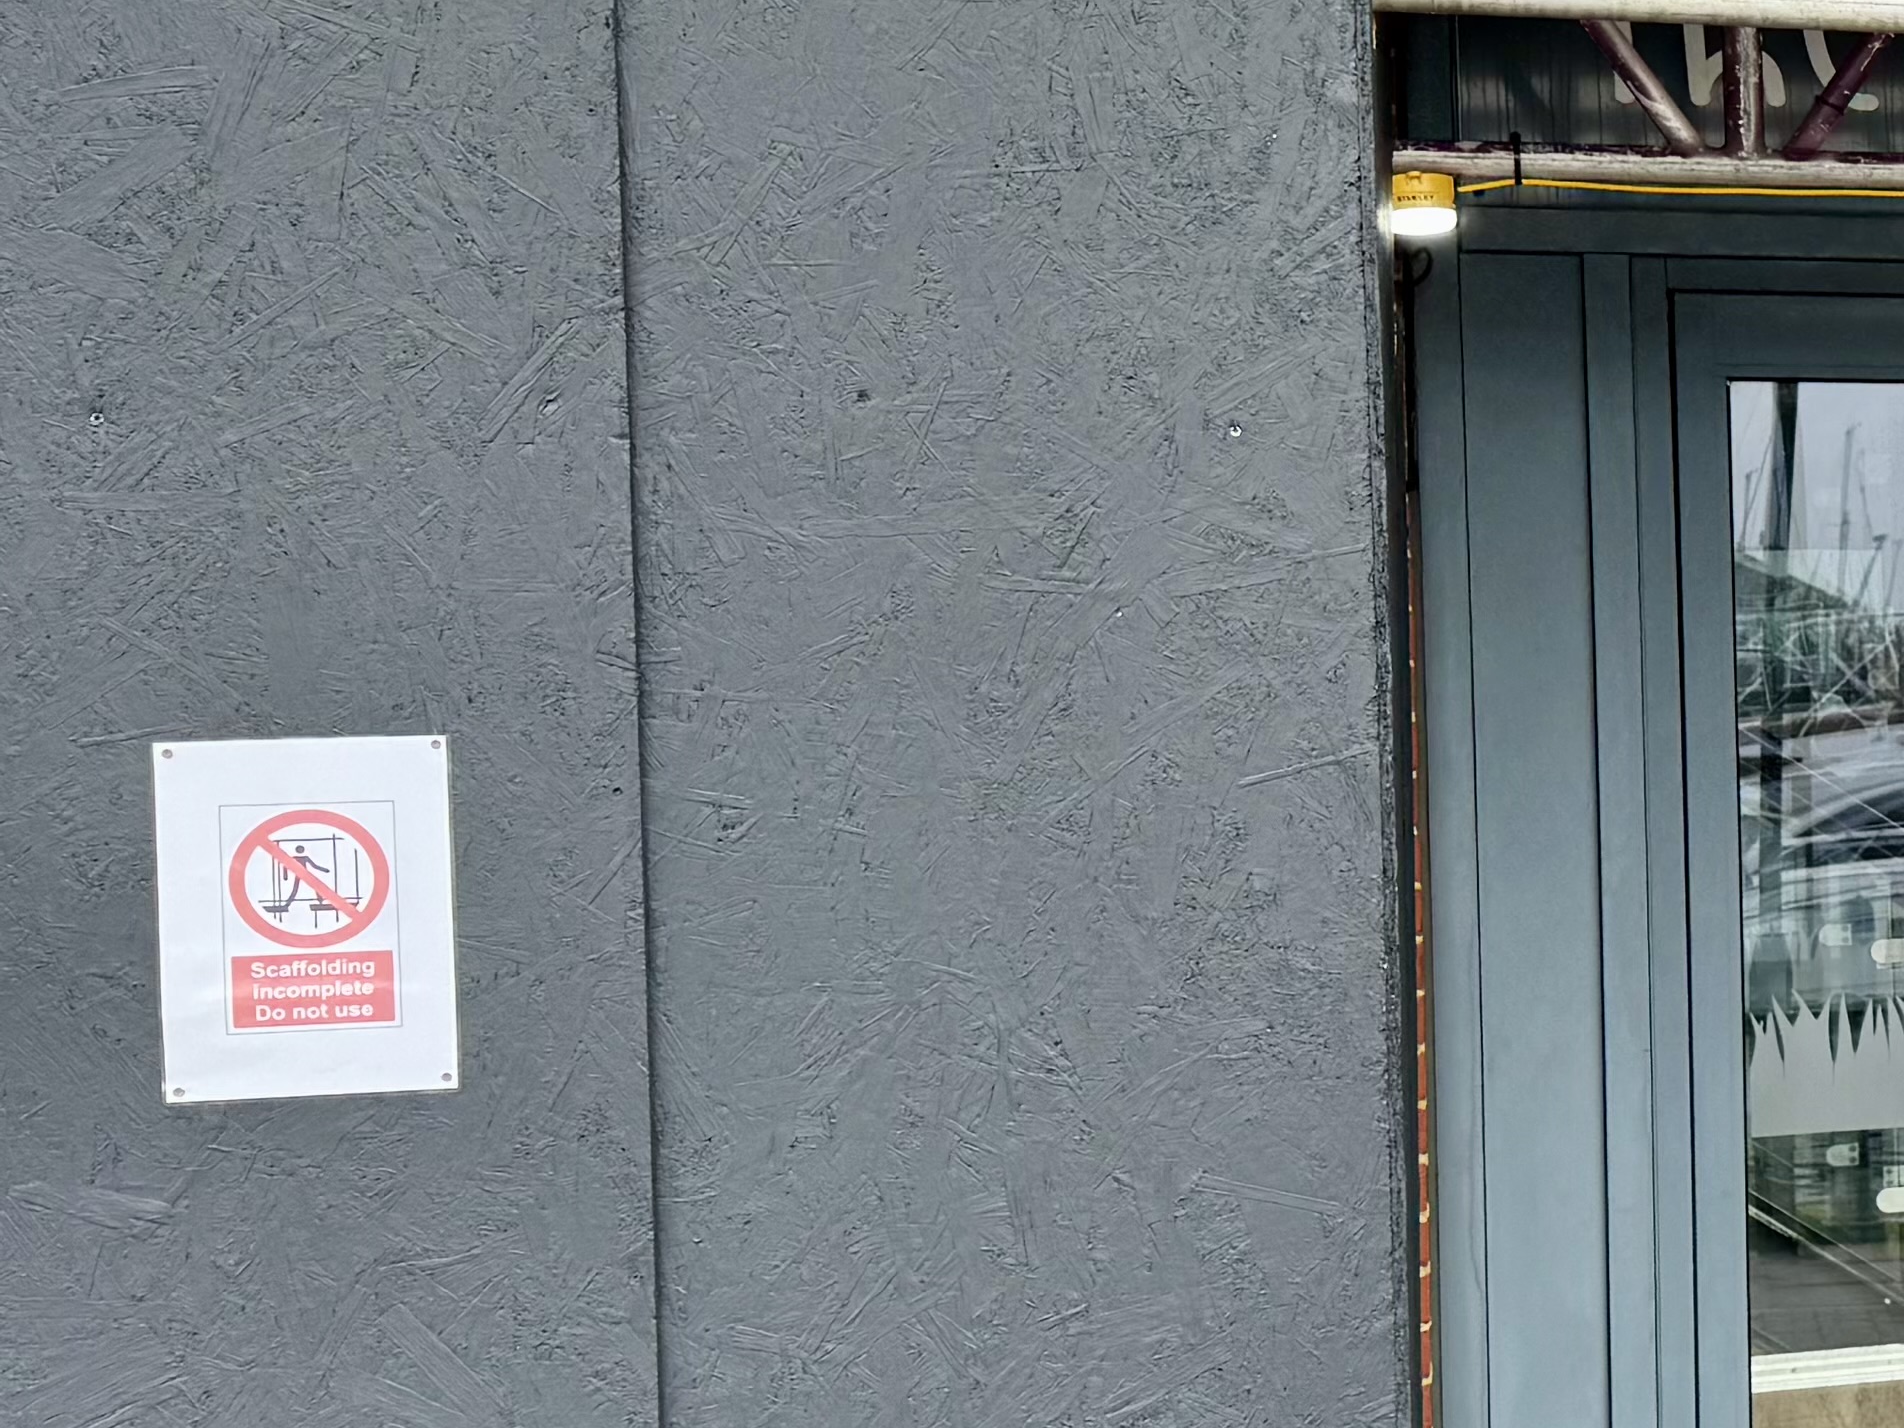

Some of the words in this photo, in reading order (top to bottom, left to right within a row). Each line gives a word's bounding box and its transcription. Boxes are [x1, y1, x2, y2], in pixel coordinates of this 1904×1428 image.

[250, 958, 376, 979] Scaffolding
[255, 1004, 286, 1022] Do
[292, 1003, 329, 1020] not
[334, 1003, 374, 1018] use
